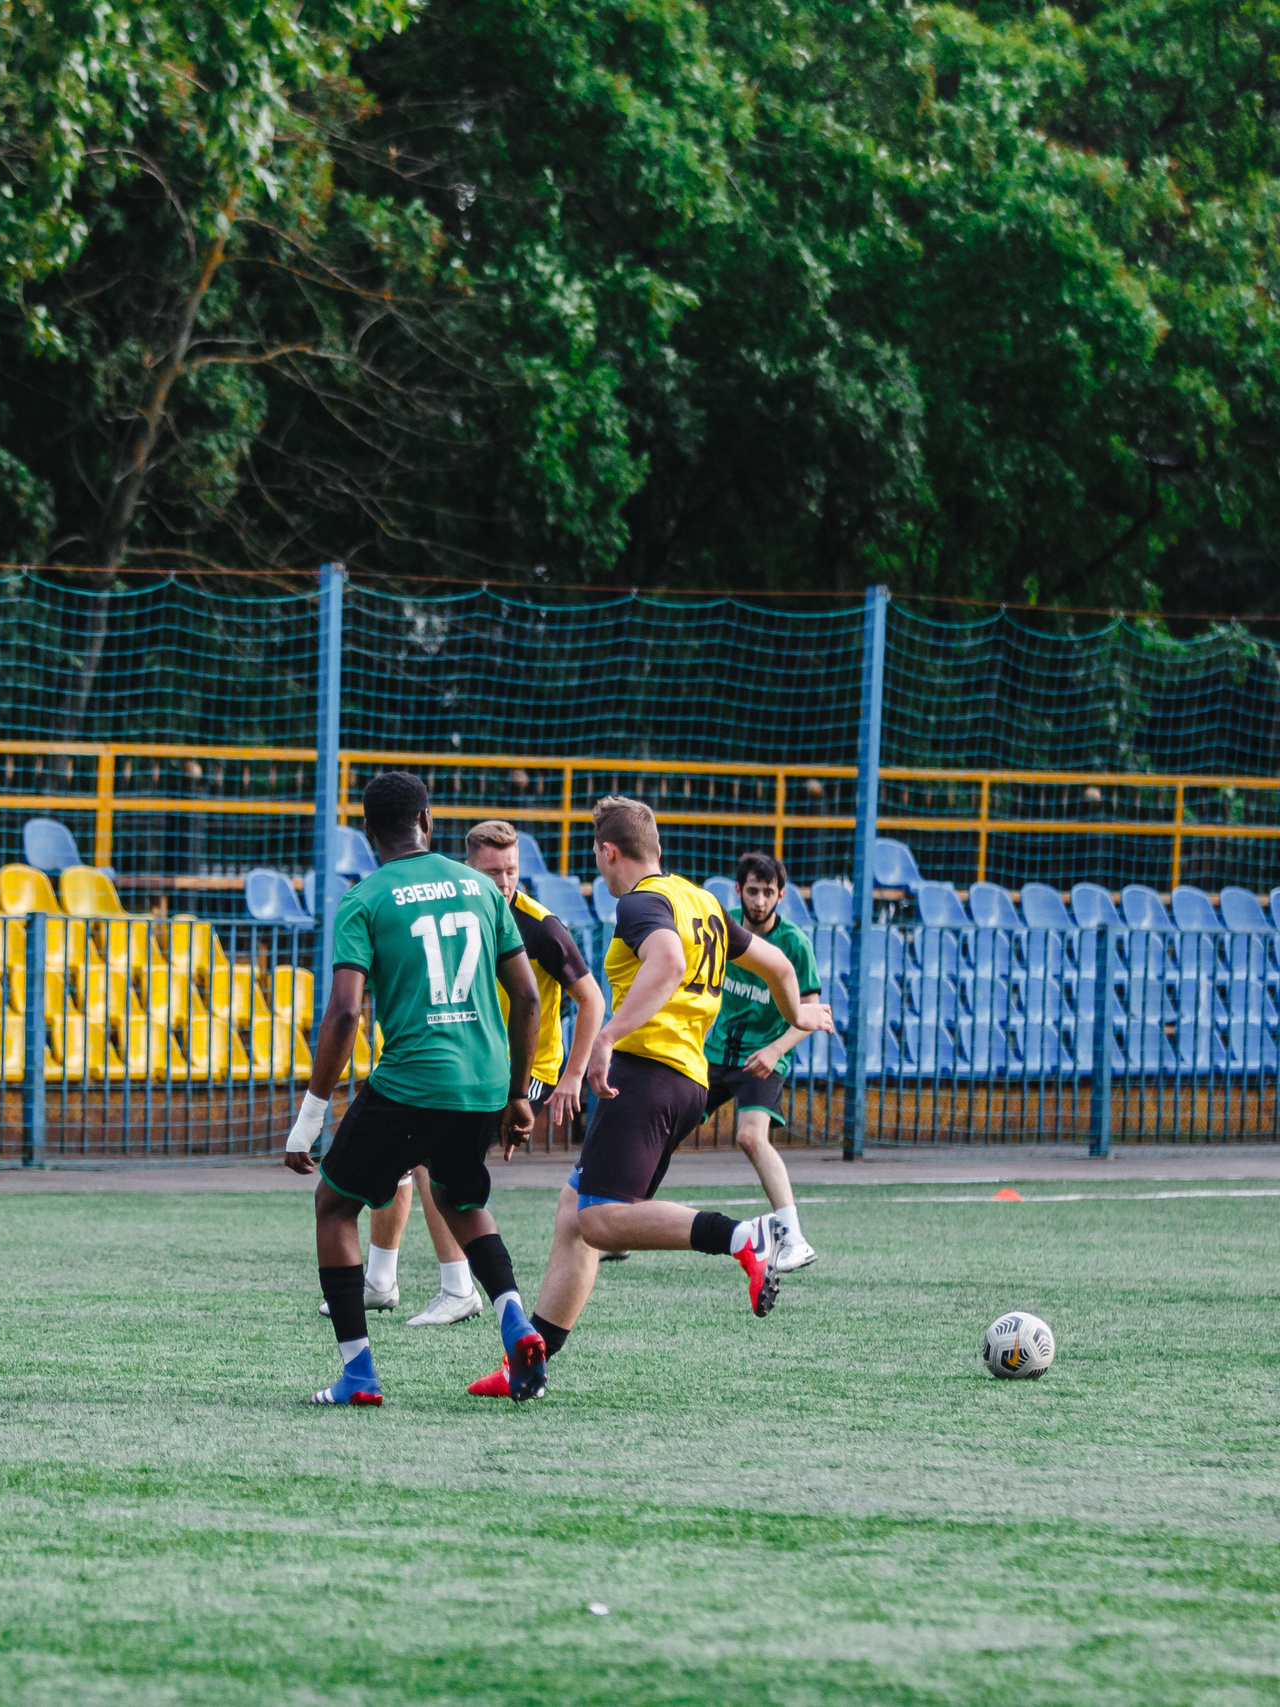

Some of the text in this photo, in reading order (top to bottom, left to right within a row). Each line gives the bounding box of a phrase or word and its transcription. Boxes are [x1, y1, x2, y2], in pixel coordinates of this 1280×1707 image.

[391, 878, 482, 906] ЭЗЕБИО JR
[410, 910, 482, 1006] 17
[683, 914, 726, 998] 20
